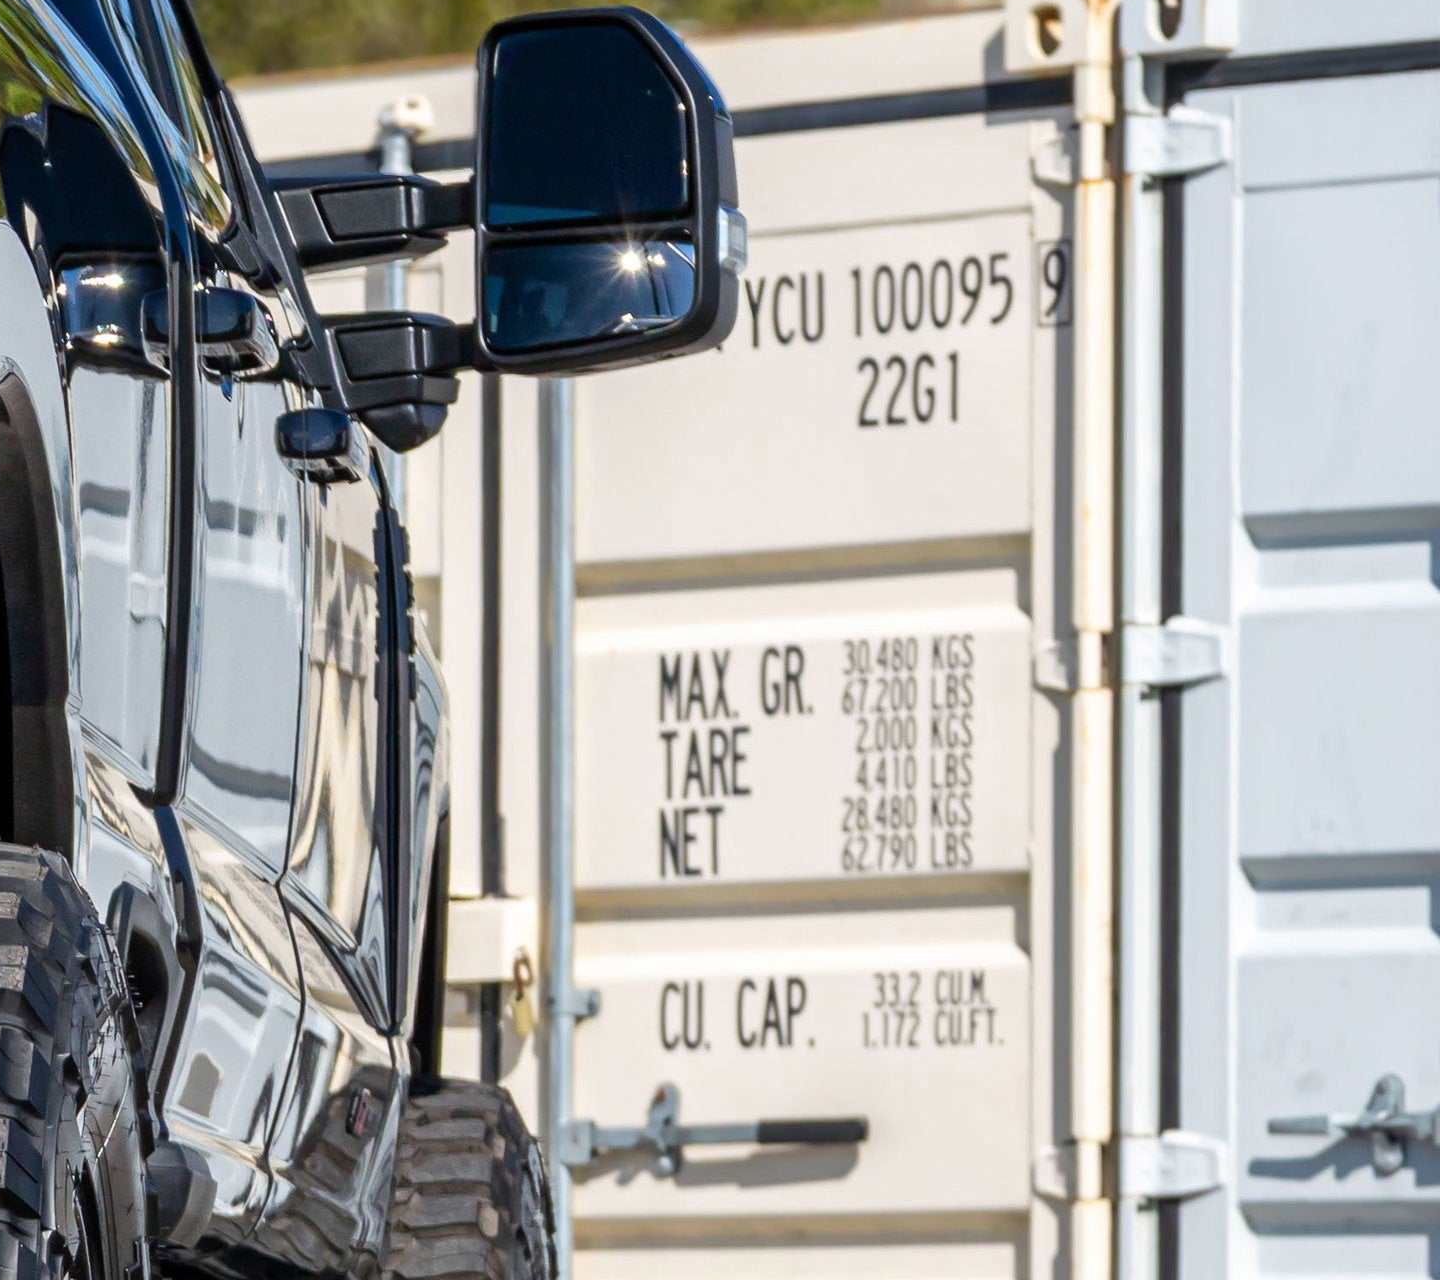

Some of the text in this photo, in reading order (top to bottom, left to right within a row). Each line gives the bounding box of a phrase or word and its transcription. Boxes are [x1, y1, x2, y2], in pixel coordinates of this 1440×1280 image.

[714, 248, 1067, 351] YCU 100095 9
[857, 351, 959, 428] 22G1
[659, 633, 974, 723] MAX. GR. 30.480 KGS
[841, 672, 974, 716] 67.200 LBS
[659, 712, 973, 800] TARE 2.000 KGS
[856, 751, 973, 791] 4.410 LBS
[659, 790, 973, 878] NET 28.480 KGS
[841, 830, 973, 871] 62.790 LBS
[659, 980, 711, 1051] CU.
[736, 977, 816, 1049] CAP.
[873, 971, 922, 1009] 33.2
[862, 1009, 921, 1049] 1.172
